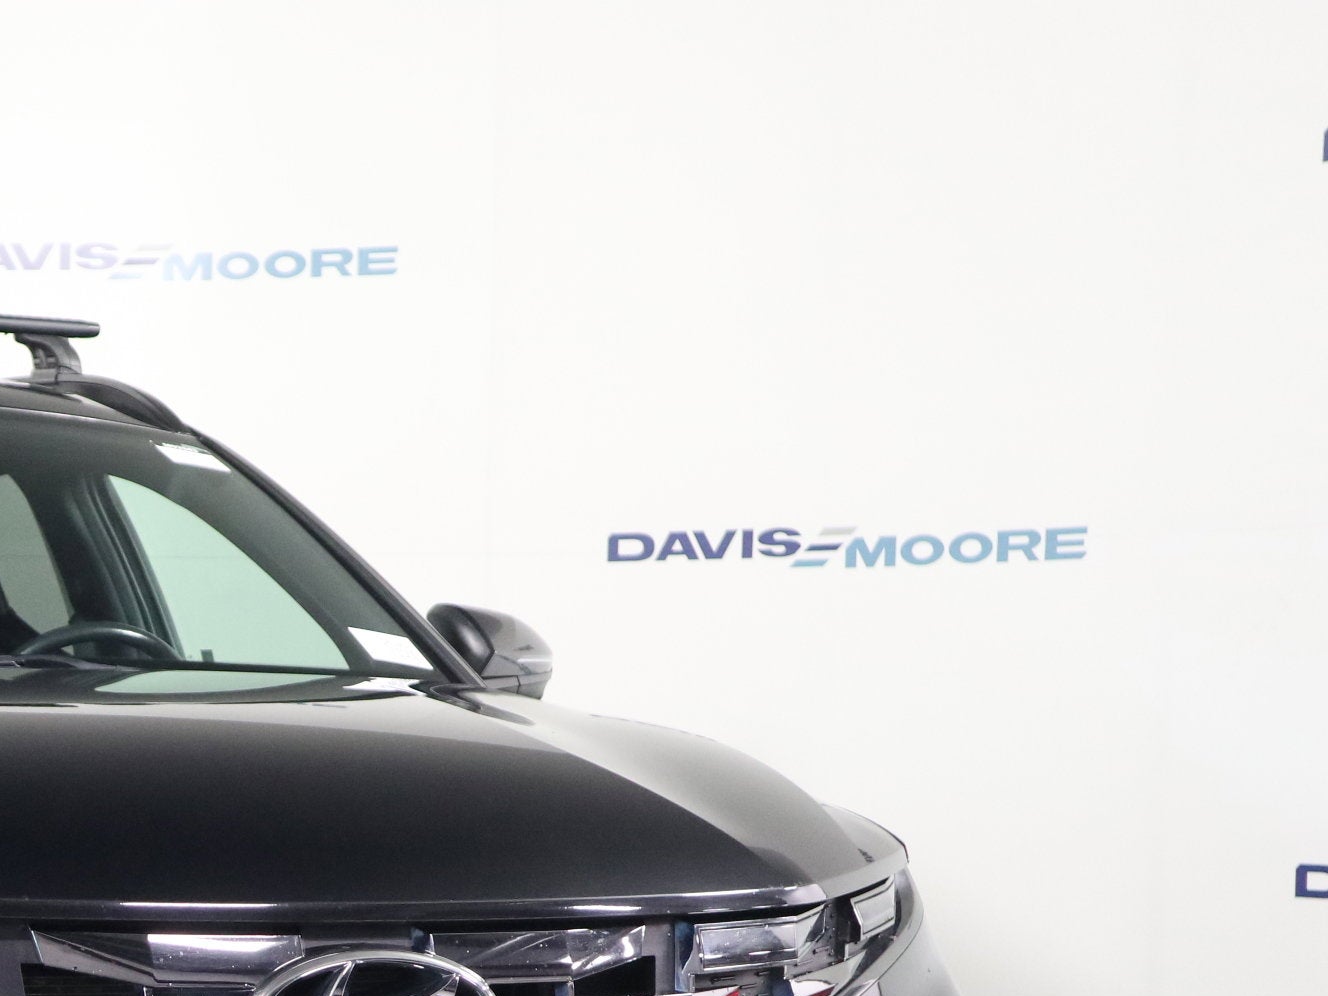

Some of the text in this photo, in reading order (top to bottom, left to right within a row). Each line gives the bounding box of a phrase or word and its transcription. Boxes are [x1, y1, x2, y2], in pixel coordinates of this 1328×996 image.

[162, 246, 398, 281] MOORE
[608, 526, 1088, 568] DAVIS MOORE
